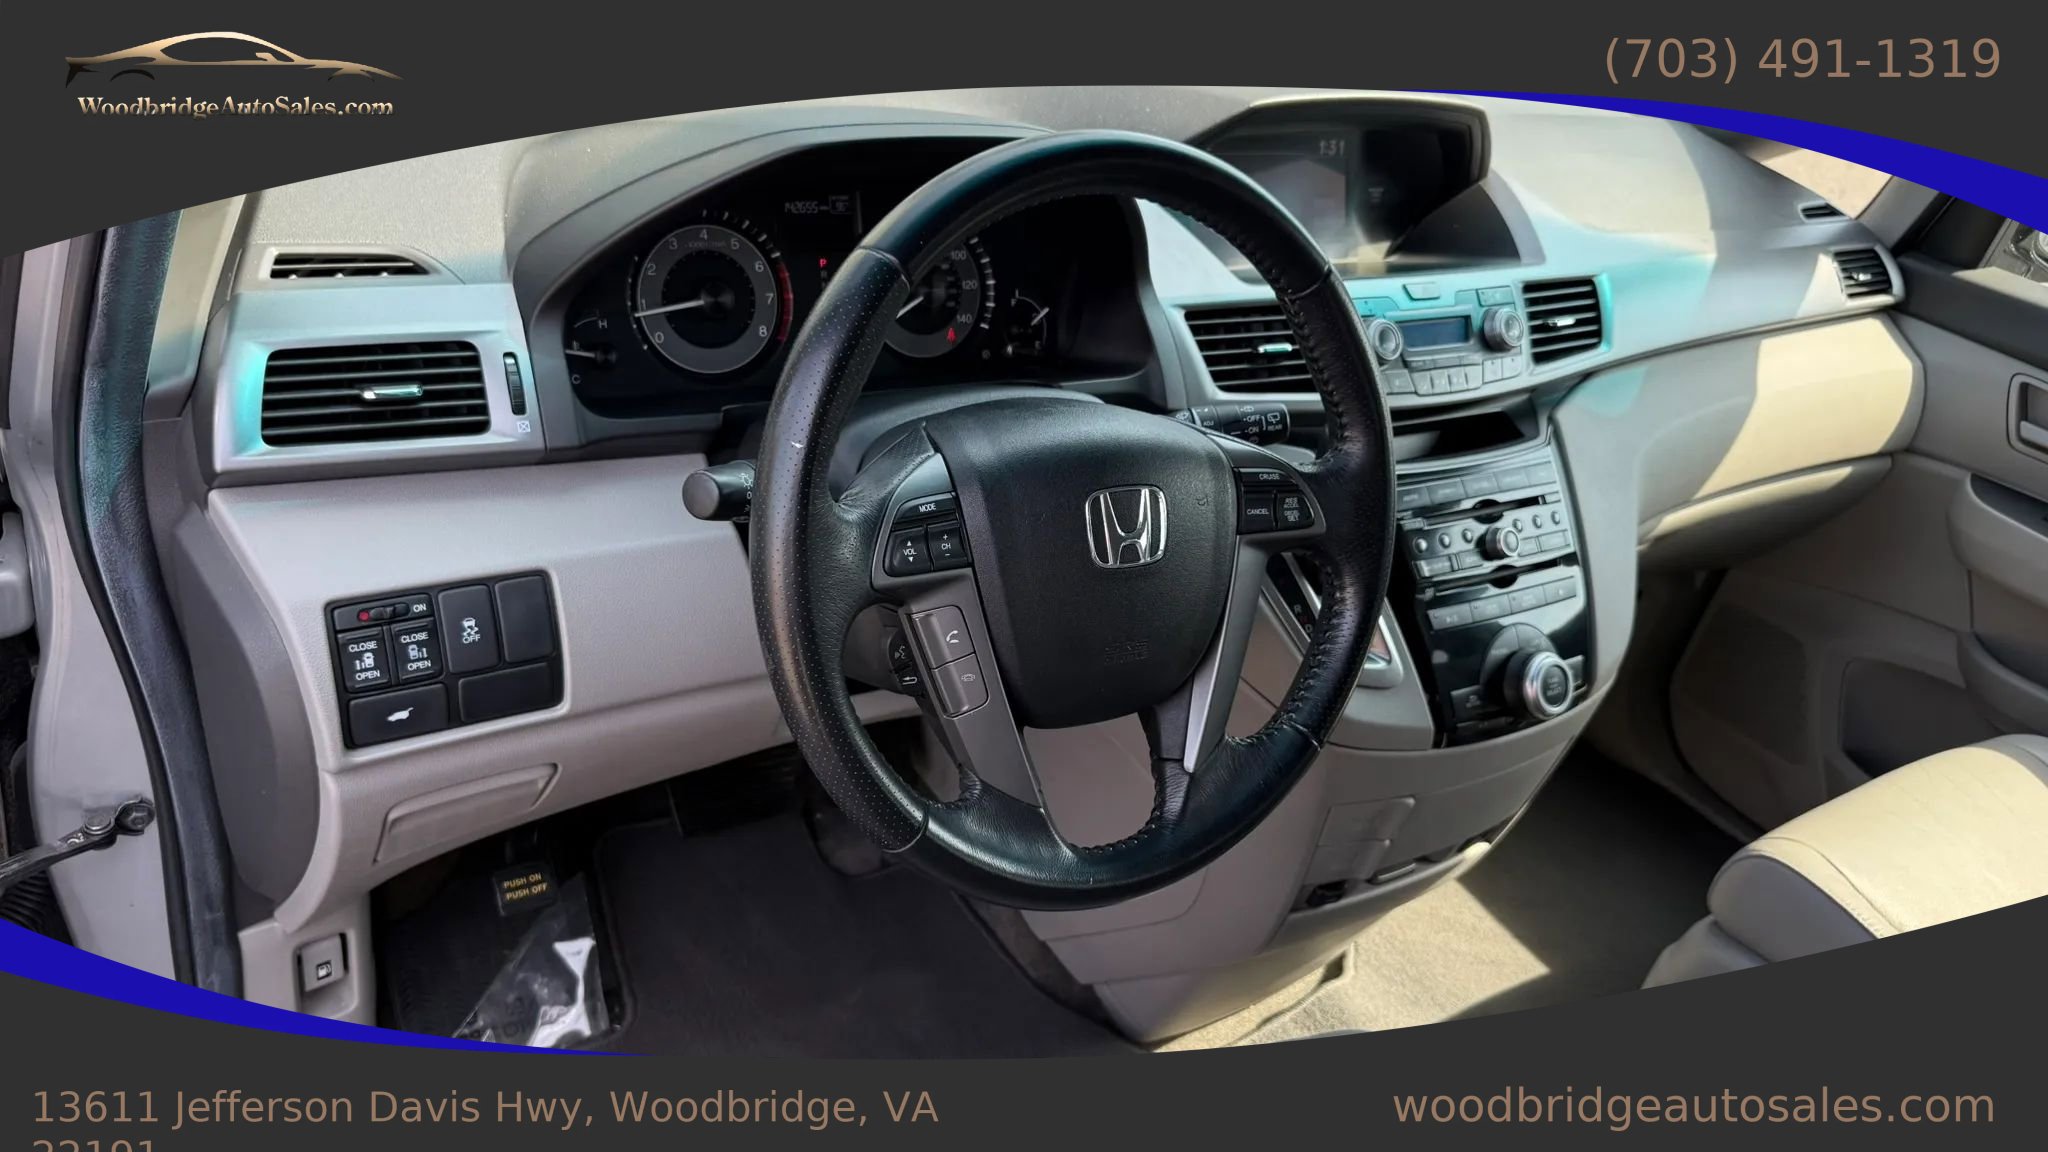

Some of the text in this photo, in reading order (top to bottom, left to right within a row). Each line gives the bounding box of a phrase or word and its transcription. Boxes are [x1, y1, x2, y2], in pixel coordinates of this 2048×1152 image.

[699, 229, 708, 240] 4
[669, 238, 678, 250] 3
[731, 239, 740, 250] 5
[951, 250, 967, 261] 100
[755, 261, 764, 272] 6
[819, 258, 827, 268] P
[647, 264, 657, 276] 2
[961, 280, 978, 290] 120
[765, 293, 774, 305] 7
[599, 319, 608, 329] H
[956, 313, 973, 324] 140
[758, 326, 768, 337] 8
[654, 332, 665, 343] 0
[571, 374, 581, 385] C
[918, 502, 937, 513] MODE
[903, 547, 918, 556] VOL
[941, 542, 952, 551] CH
[412, 603, 427, 612] ON
[400, 631, 430, 643] CLOSE
[462, 633, 481, 644] OFF
[348, 640, 378, 653] CLOSE
[407, 659, 432, 671] OPEN
[355, 670, 381, 681] OPEN
[503, 872, 542, 889] PUSH ON
[506, 882, 548, 901] PUSH OFF
